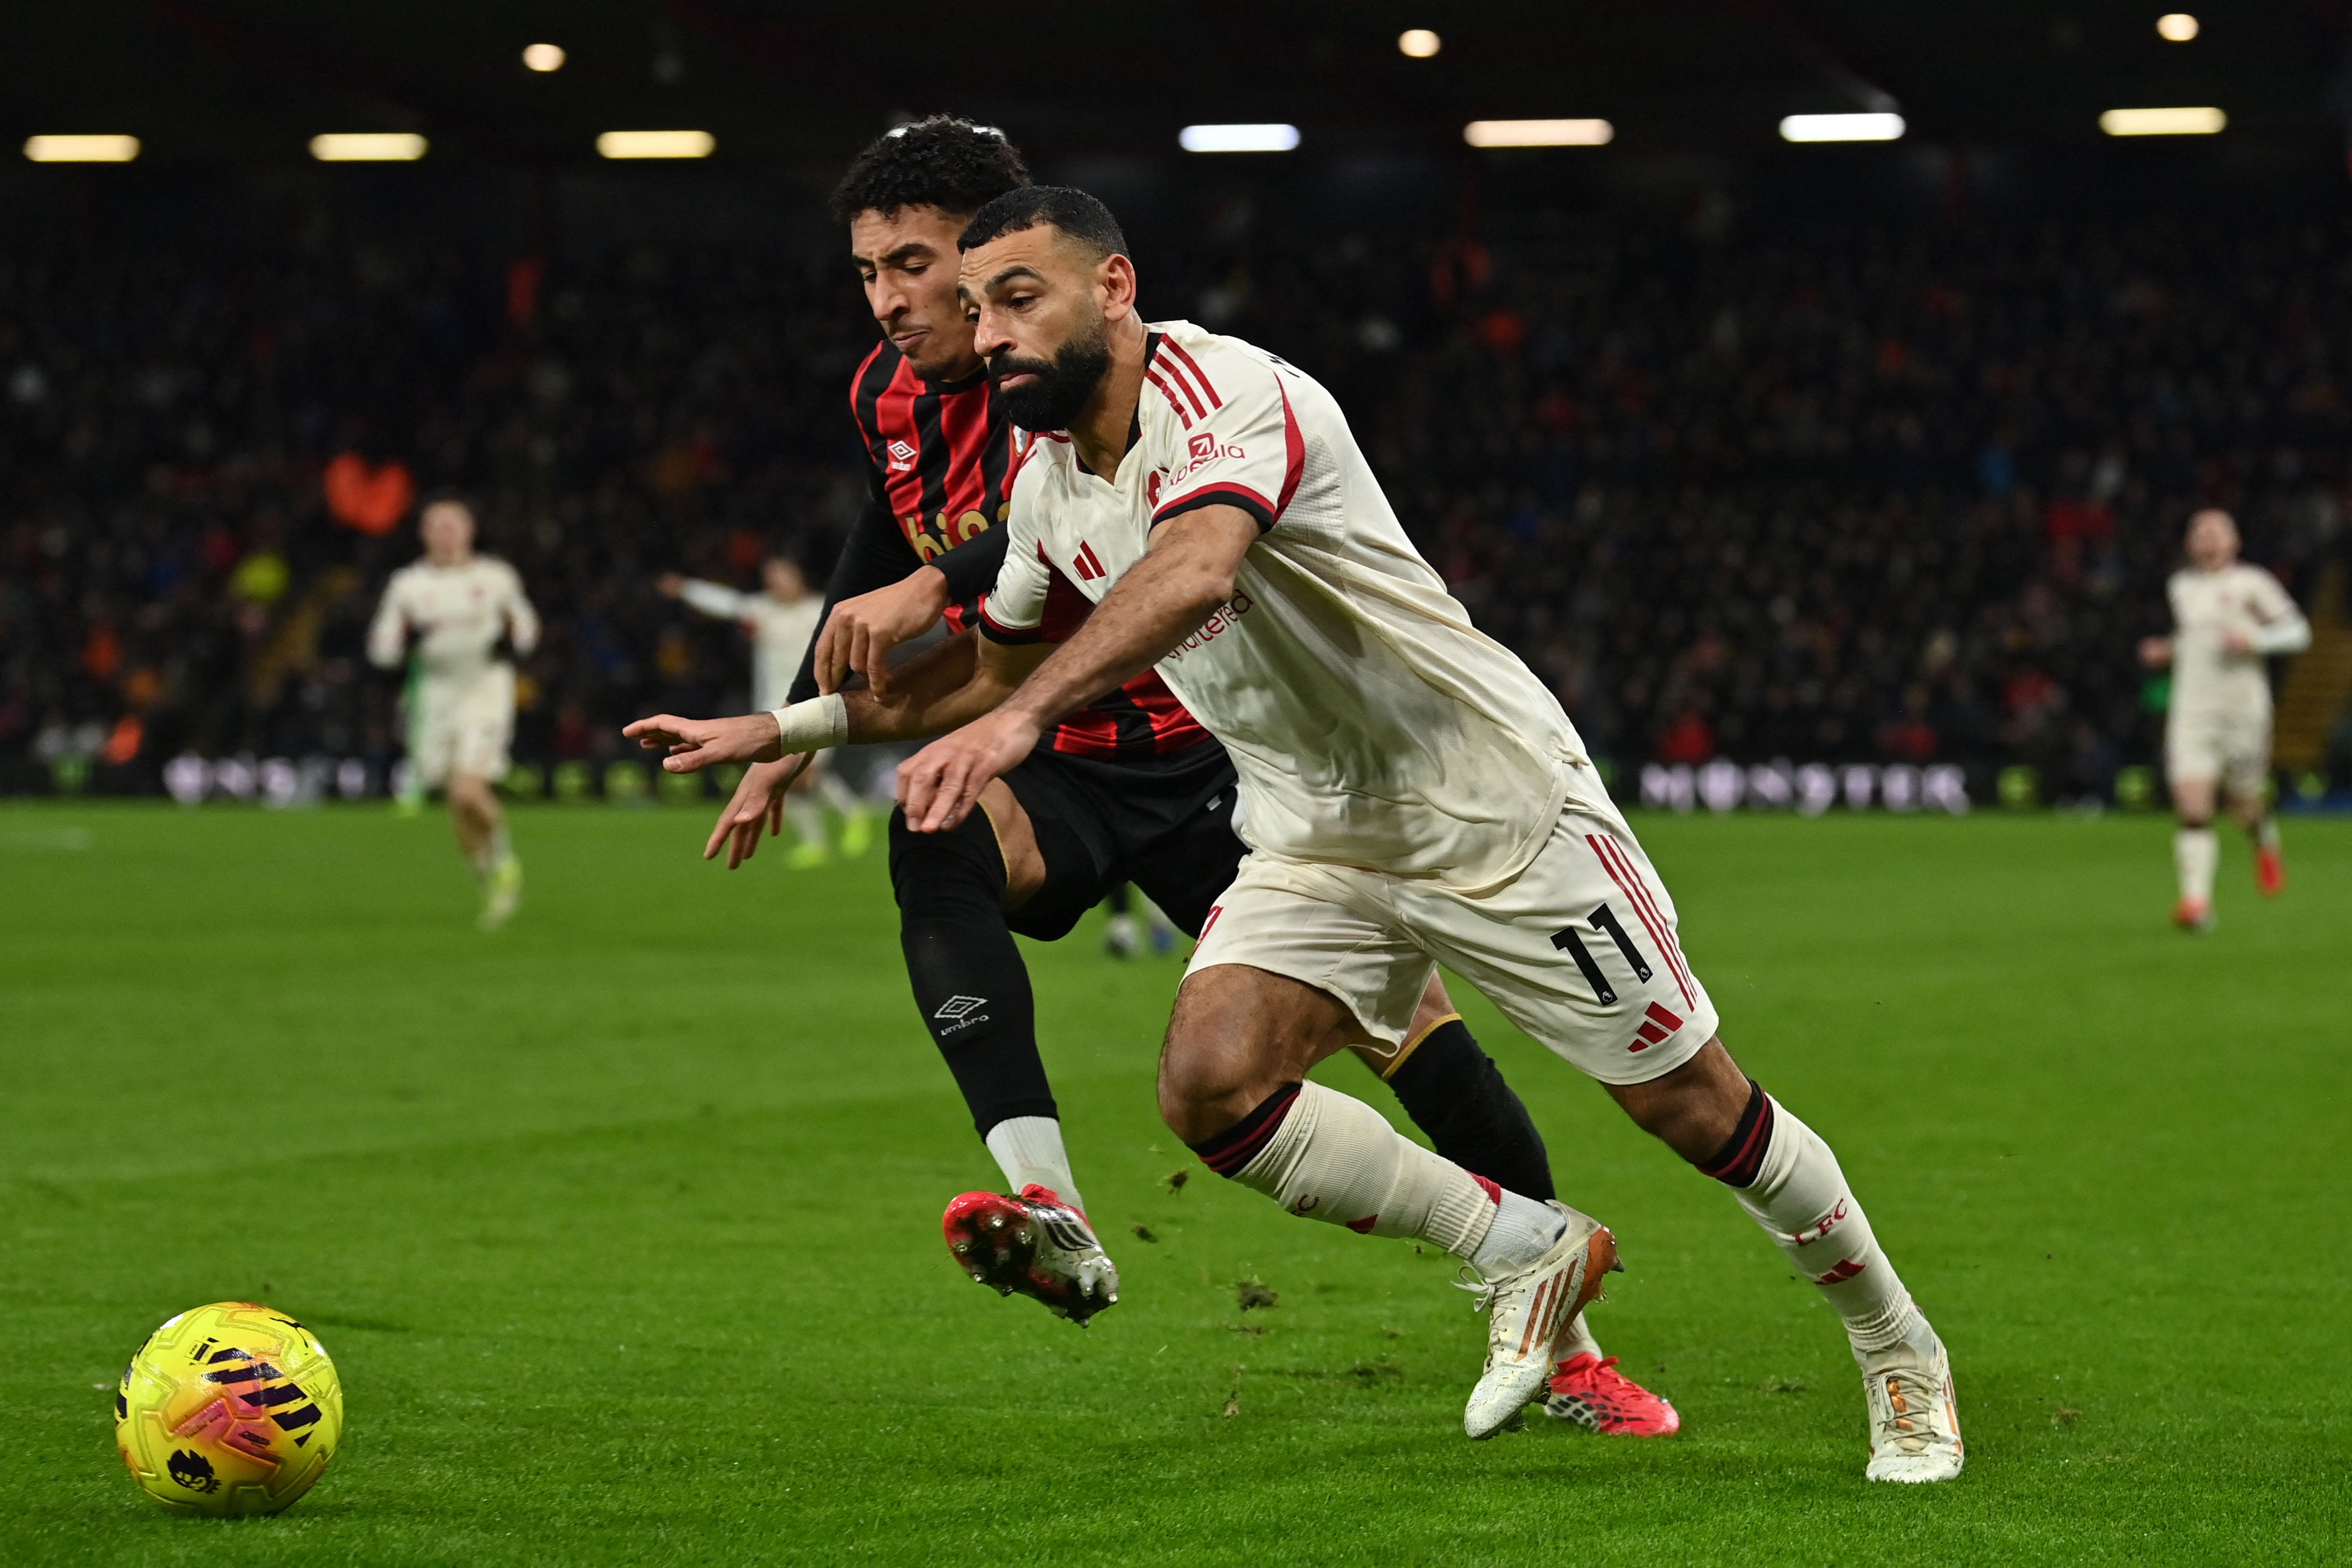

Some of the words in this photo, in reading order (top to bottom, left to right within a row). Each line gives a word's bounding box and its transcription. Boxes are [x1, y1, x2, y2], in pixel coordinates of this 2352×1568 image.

[1550, 902, 1653, 1007] 11
[941, 1015, 990, 1036] umbro
[1793, 1197, 1847, 1247] LFC
